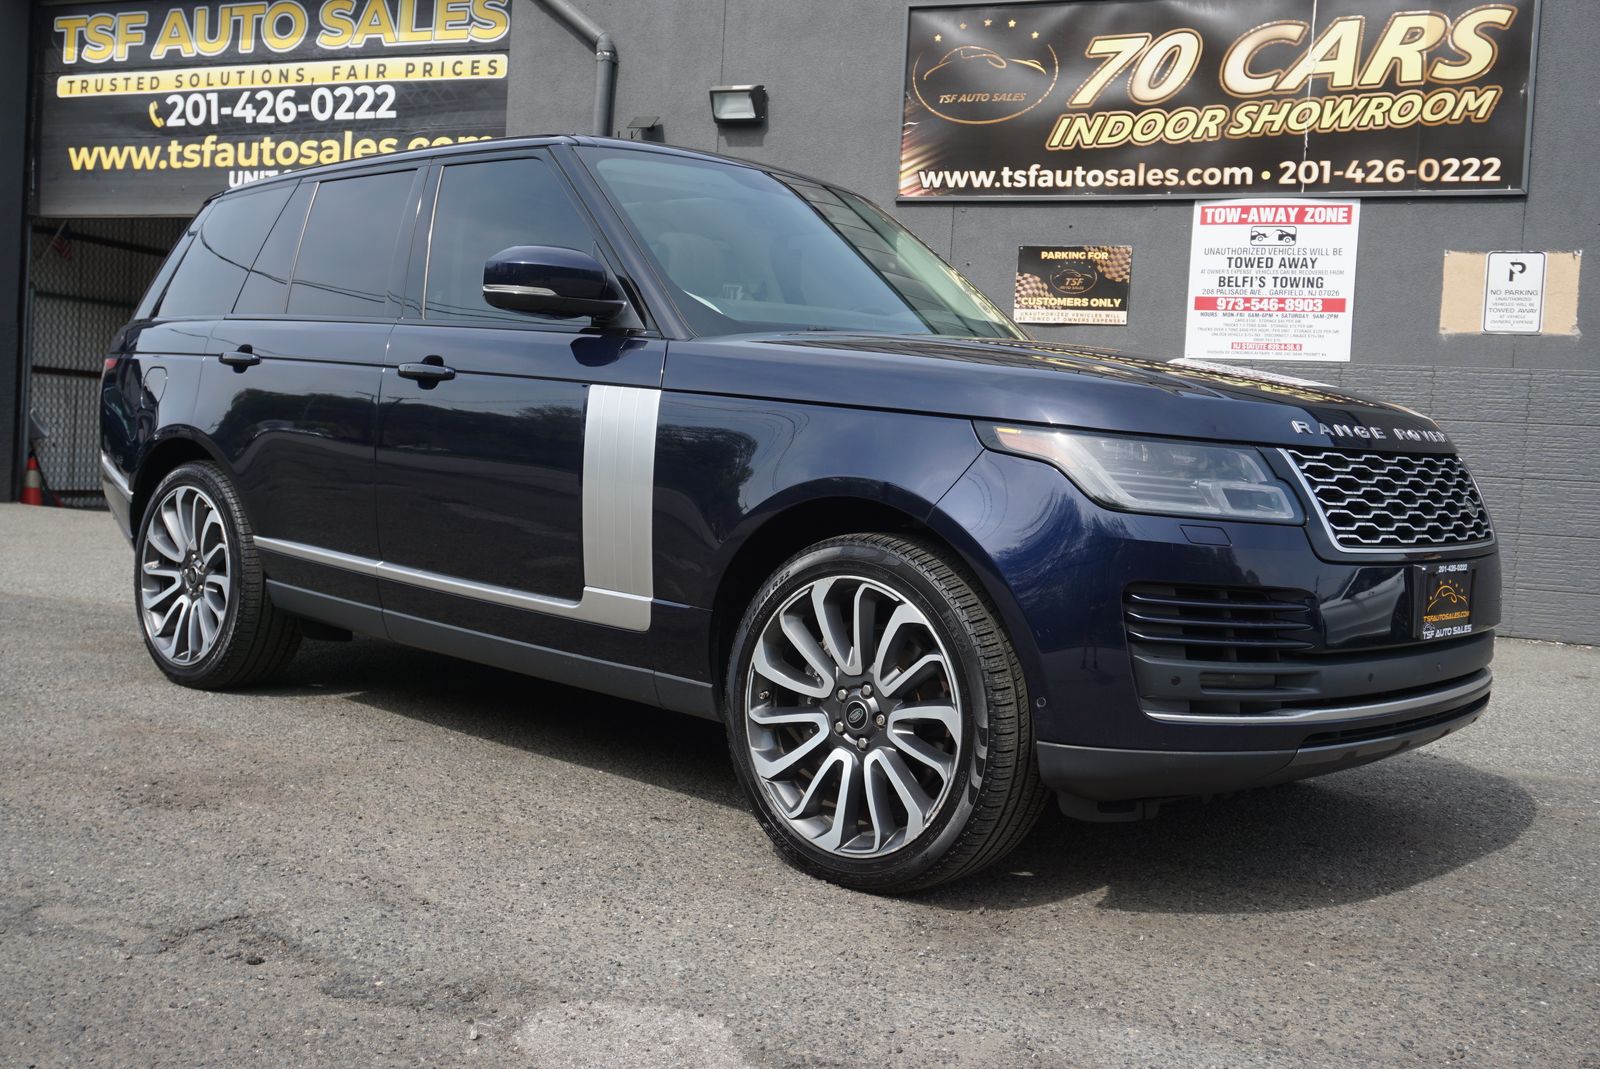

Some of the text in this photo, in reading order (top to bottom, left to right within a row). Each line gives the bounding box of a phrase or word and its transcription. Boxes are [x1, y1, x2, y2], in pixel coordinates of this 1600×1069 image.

[54, 0, 510, 64] TSF AUTO SALES
[1067, 3, 1518, 108] 70 CARS
[67, 59, 499, 94] TRUSTED SOLUTIONS, FAIR PRICES
[165, 84, 396, 127] 201-426-0222
[939, 93, 1026, 104] TSF AUTO SALES
[1046, 85, 1503, 150] INDOOR SHOWROOM
[68, 130, 494, 171] www.tsfautosales
[919, 157, 1502, 189] www.tsfautosales.com 201-426-0222
[1204, 207, 1349, 223] TOW-AWAY ZONE
[1041, 251, 1109, 260] PARKING FOR
[1203, 247, 1343, 256] UNAUTHORIZED VEHICLES WILL BE
[1227, 257, 1318, 269] TOWED AWAY
[1218, 276, 1324, 289] BELFI'S TOWING
[1021, 297, 1122, 308] CUSTOMERS ONLY
[1216, 298, 1323, 312] 973-546-8903
[1291, 420, 1447, 443] RANGE ROVER
[1423, 624, 1472, 640] TSF AUTO SALES
